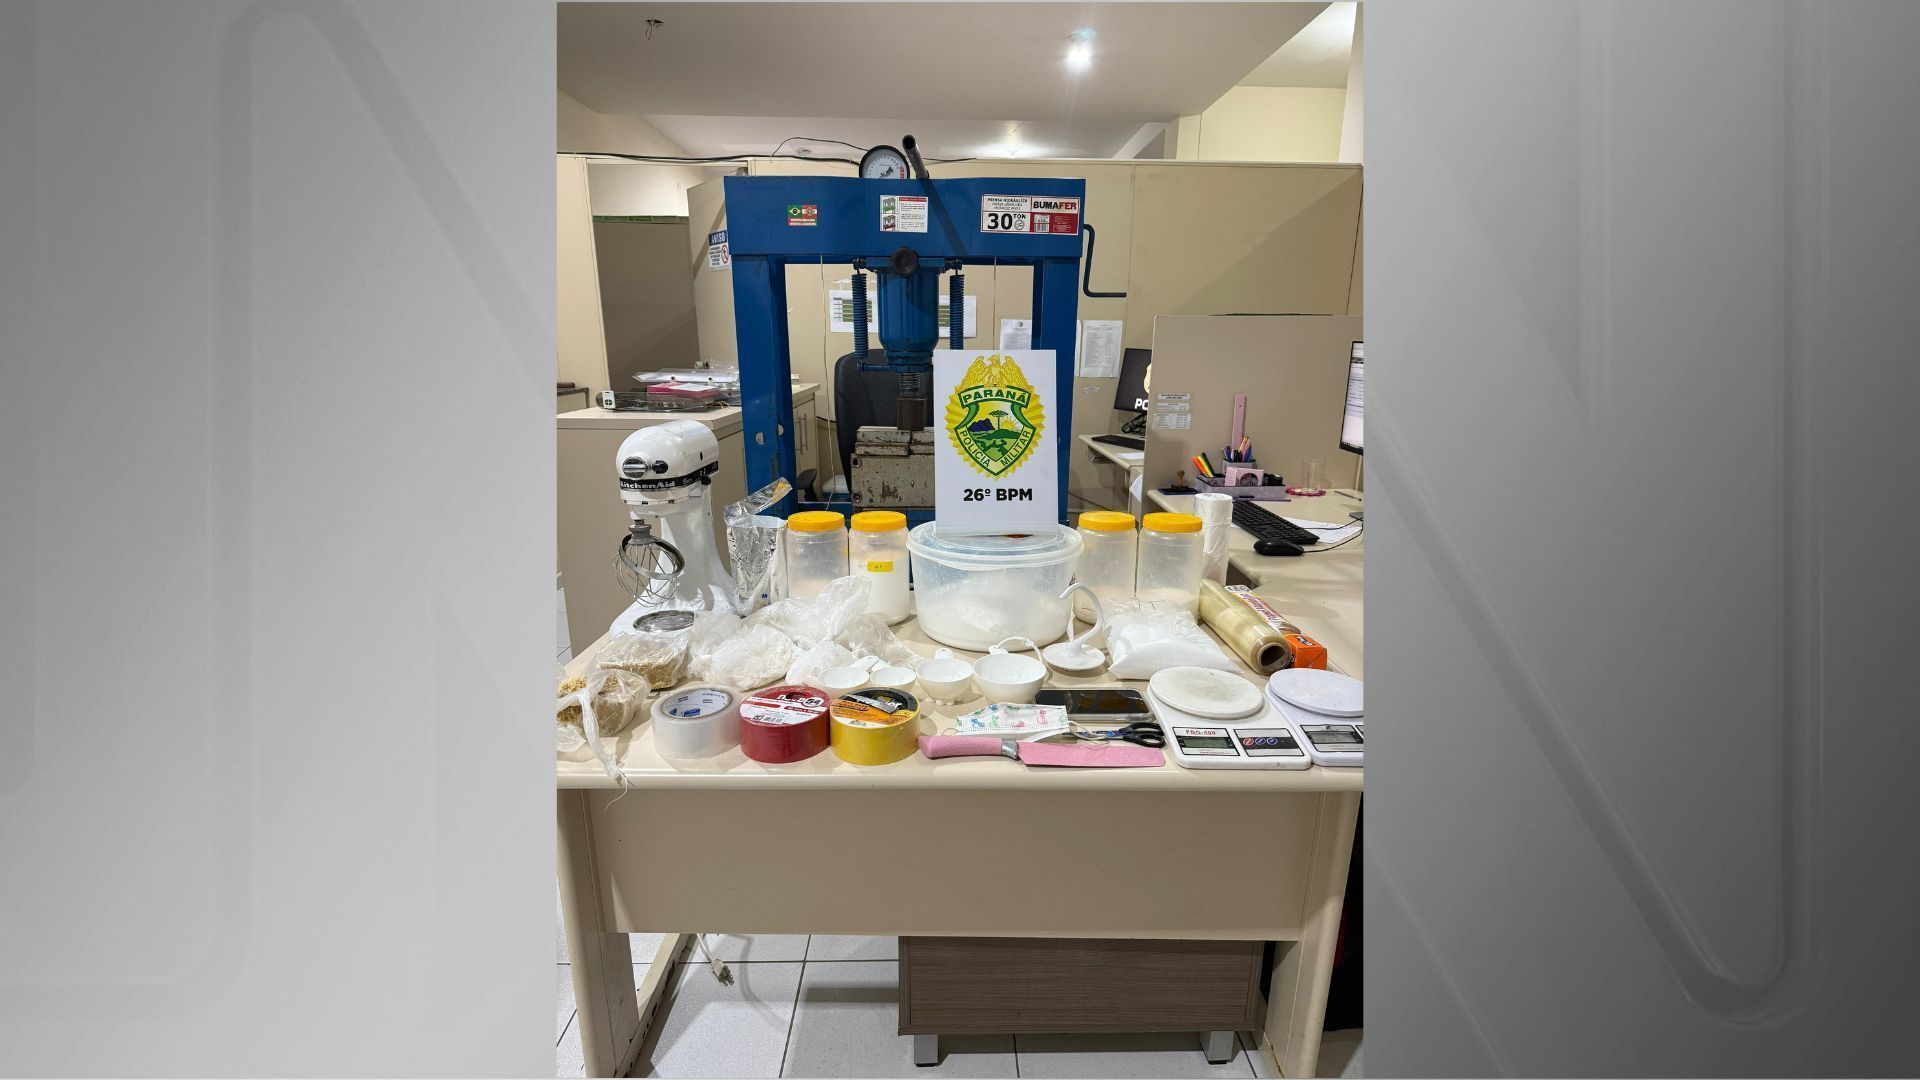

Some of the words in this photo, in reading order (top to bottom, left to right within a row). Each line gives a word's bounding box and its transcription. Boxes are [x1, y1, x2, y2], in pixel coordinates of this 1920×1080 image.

[1033, 201, 1077, 210] BUMAFER
[987, 213, 1013, 230] 30
[964, 389, 1027, 403] PARANÁ
[1000, 430, 1031, 467] MILITAR
[963, 488, 991, 501] 26º
[996, 488, 1033, 501] BPM
